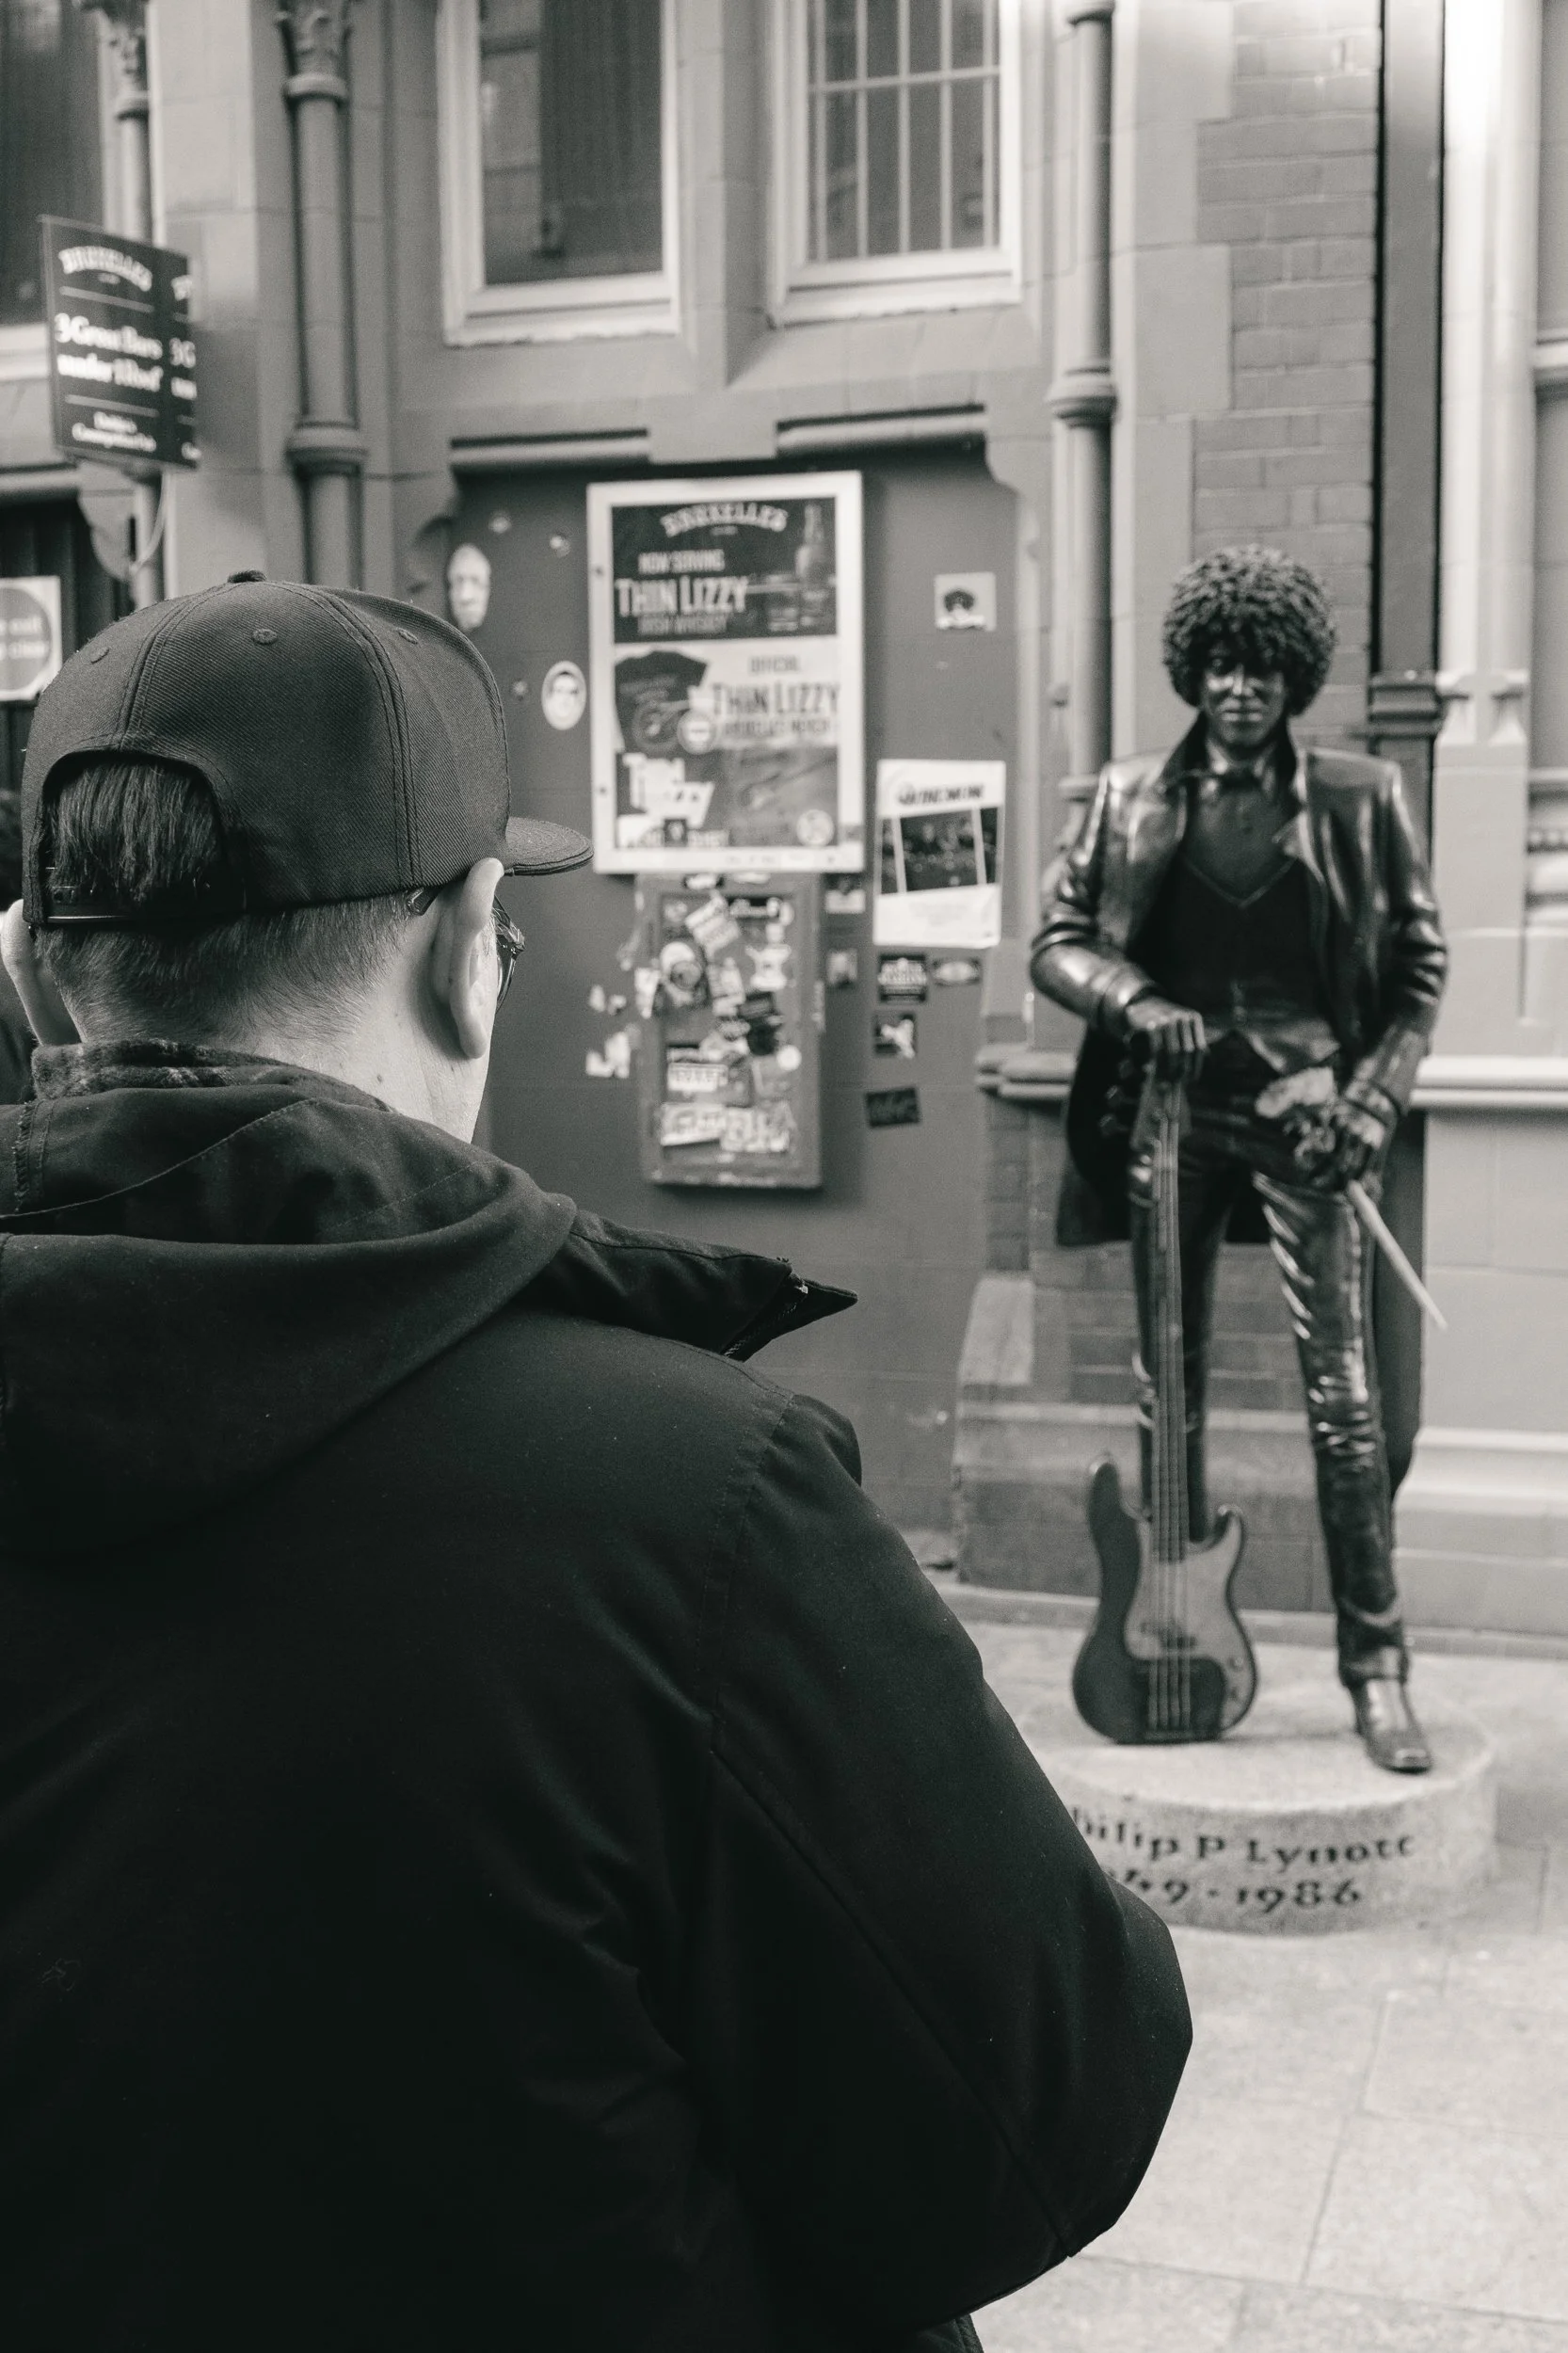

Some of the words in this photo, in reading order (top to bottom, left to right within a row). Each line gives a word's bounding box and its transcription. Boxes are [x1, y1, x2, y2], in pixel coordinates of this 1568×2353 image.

[55, 312, 72, 344] 3
[1071, 1806, 1179, 1862] hilip
[1198, 1835, 1225, 1860] P
[1247, 1835, 1414, 1874] Lynott
[1236, 1878, 1361, 1914] 1986
